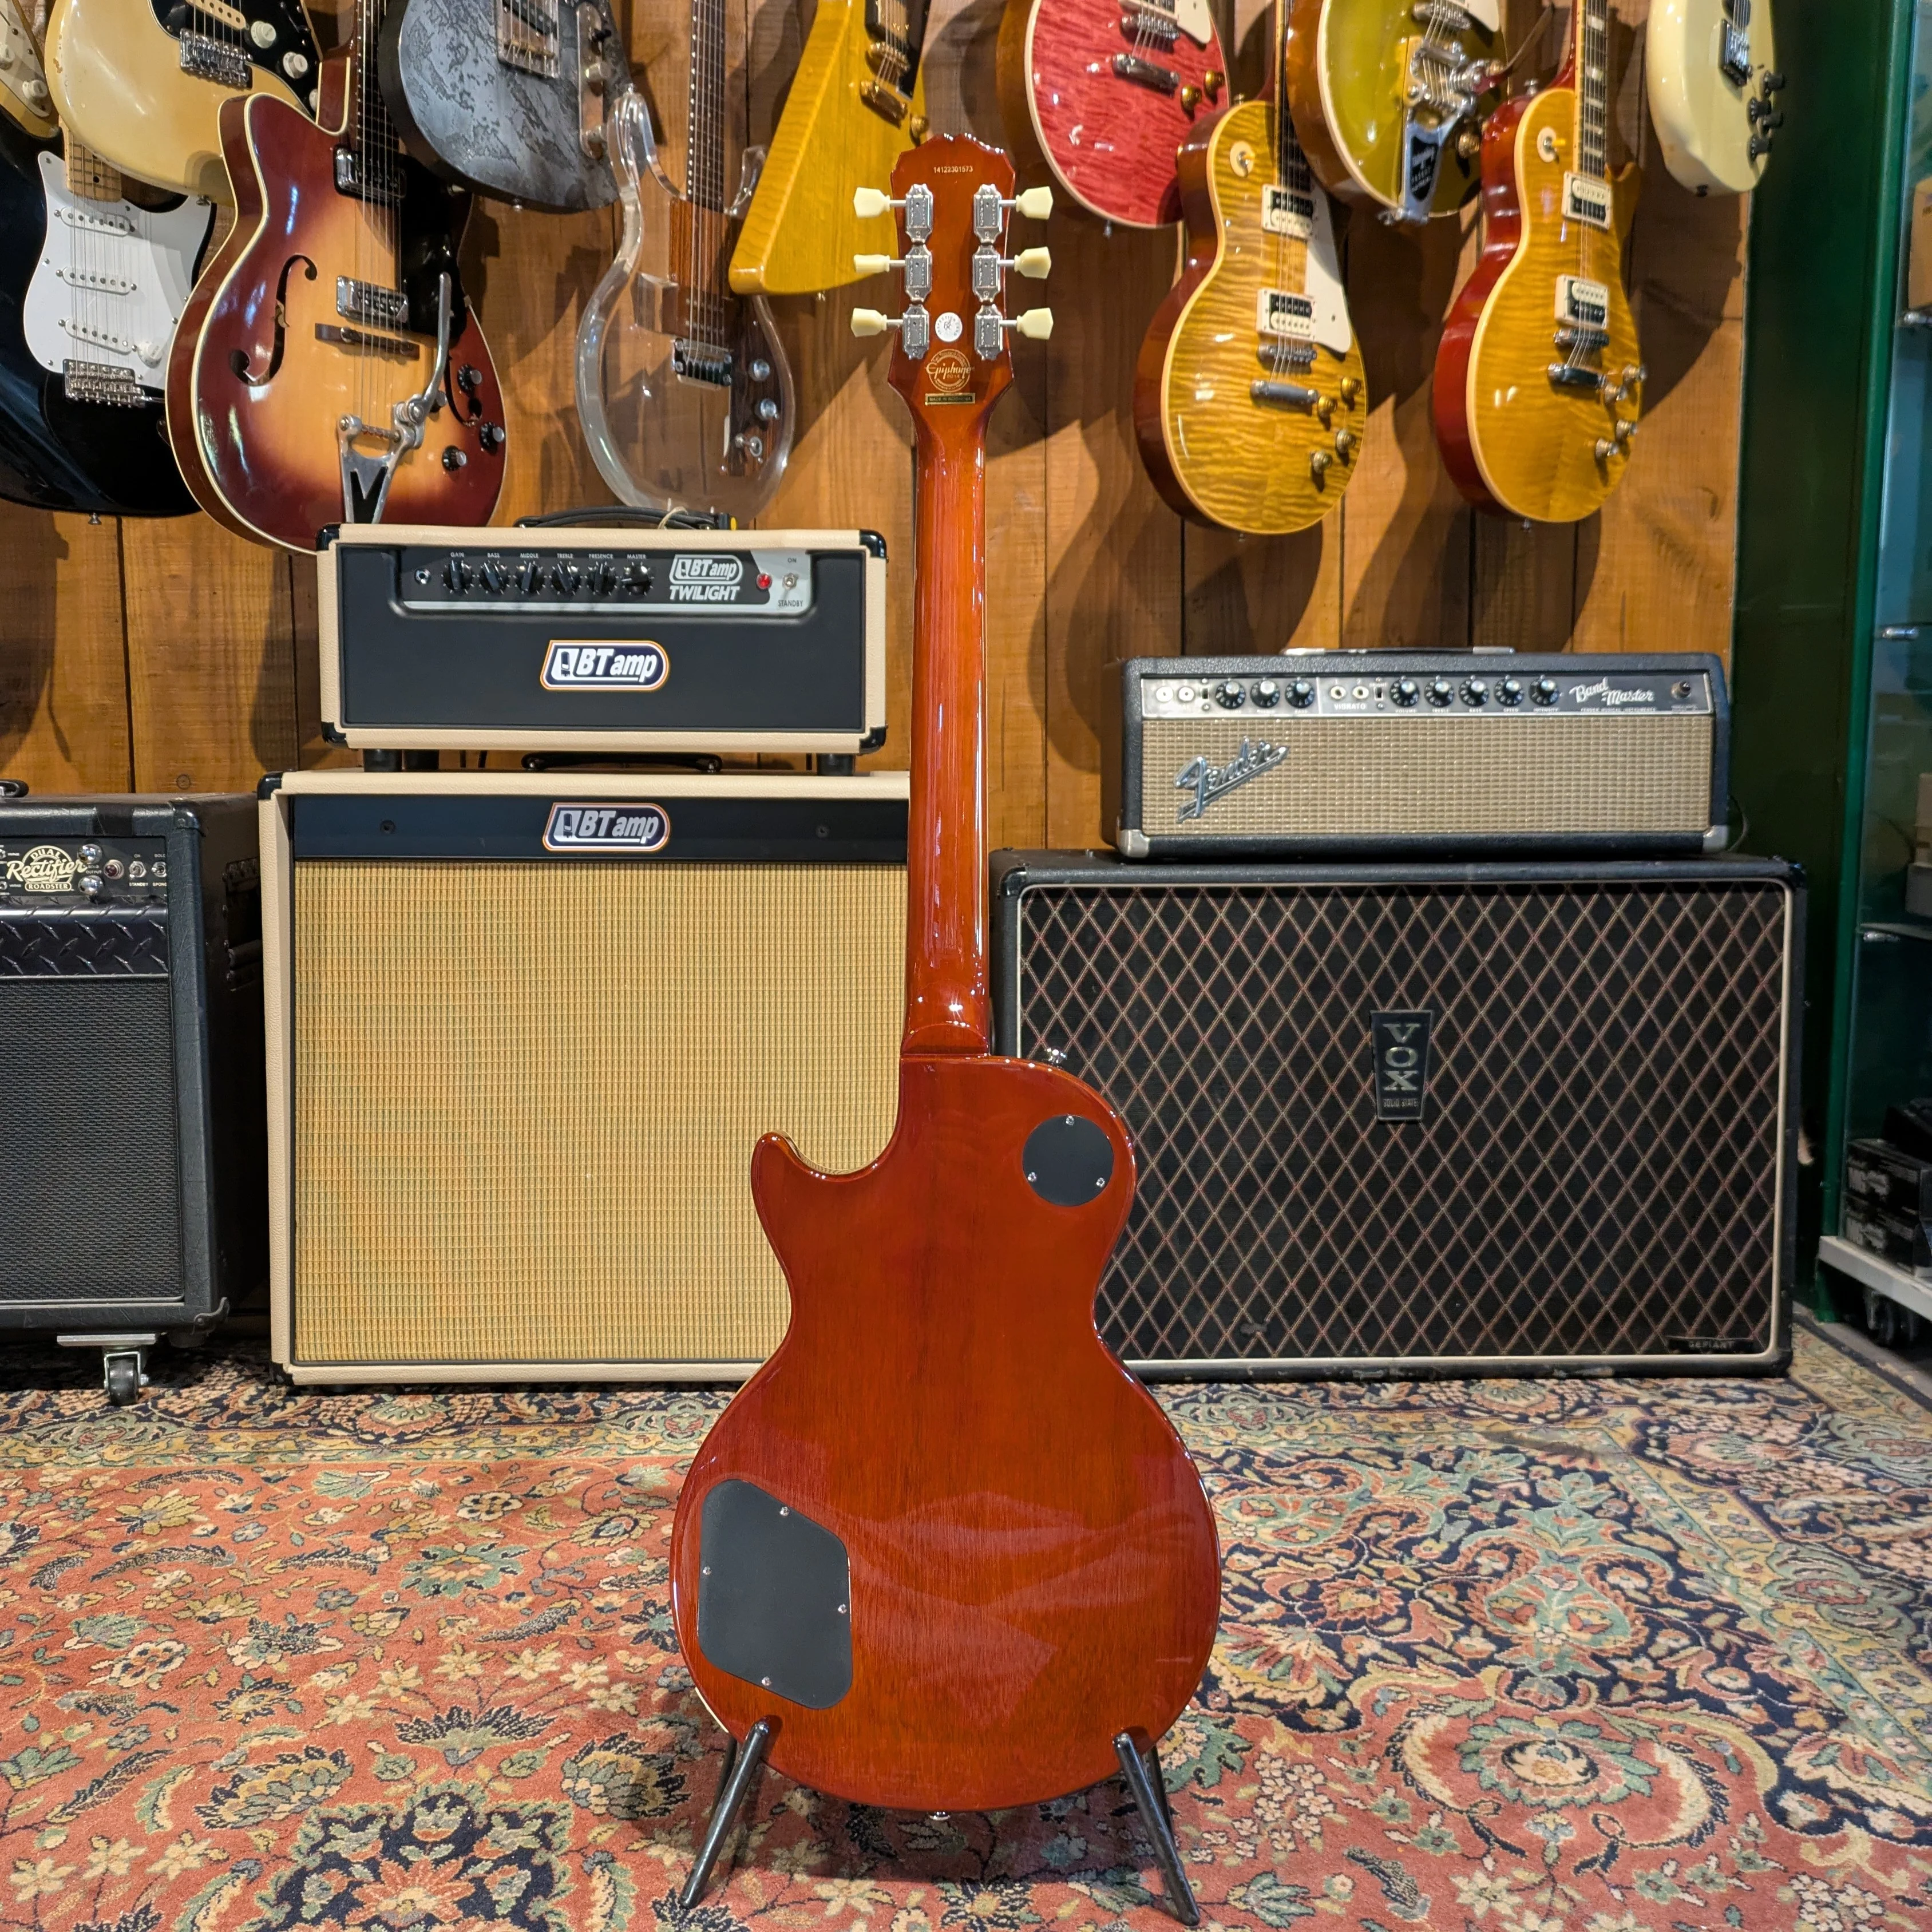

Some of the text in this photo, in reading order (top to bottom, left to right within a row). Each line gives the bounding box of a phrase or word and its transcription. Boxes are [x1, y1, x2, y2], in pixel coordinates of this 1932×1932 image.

[925, 362, 972, 379] Epiphone
[670, 585, 740, 600] TWILIGHT
[1569, 676, 1655, 706] Band Master
[1175, 735, 1289, 823] Fender
[30, 848, 61, 860] DUAL
[6, 858, 88, 882] Rectifier
[1382, 1023, 1422, 1091] VOX
